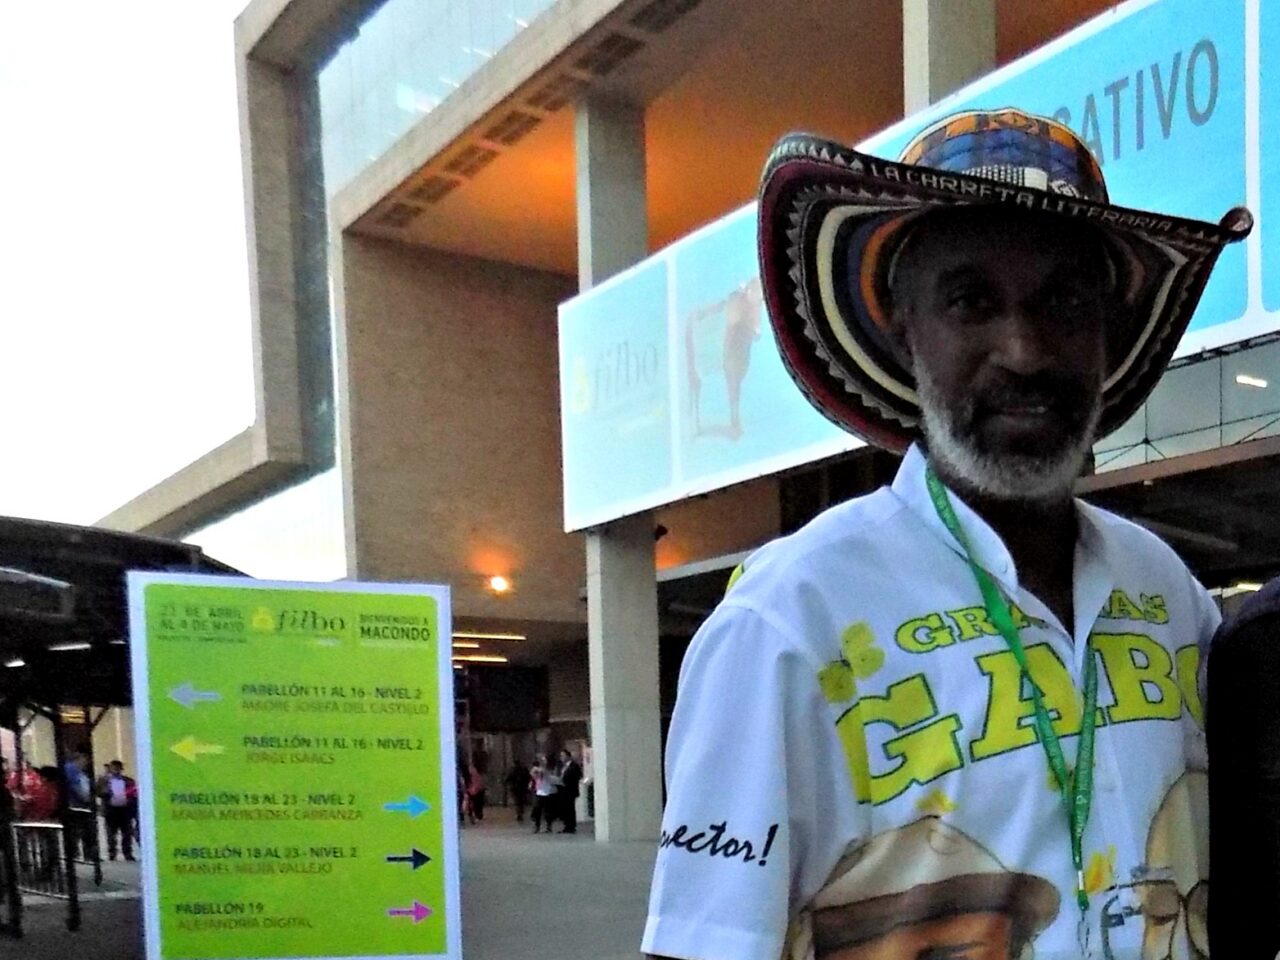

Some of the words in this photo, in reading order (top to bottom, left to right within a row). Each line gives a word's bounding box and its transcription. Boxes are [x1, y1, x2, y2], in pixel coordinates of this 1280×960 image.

[872, 165, 900, 182] LA
[906, 172, 1034, 211] CARRETA
[1042, 196, 1173, 232] LITERARIA
[274, 609, 345, 632] filbo
[360, 625, 431, 642] MACONDO
[331, 686, 346, 698] AL
[375, 687, 411, 699] NIVEL
[414, 688, 423, 700] 2
[333, 737, 348, 749] AL
[376, 738, 413, 750] NIVEL
[416, 738, 425, 751] 2
[308, 793, 345, 806] NIVEL
[347, 793, 356, 806] 2
[264, 847, 281, 859] AL
[310, 847, 347, 859] NIVEL
[350, 847, 358, 858] 2
[248, 902, 264, 914] 19
[263, 916, 314, 929] DIGITAL
